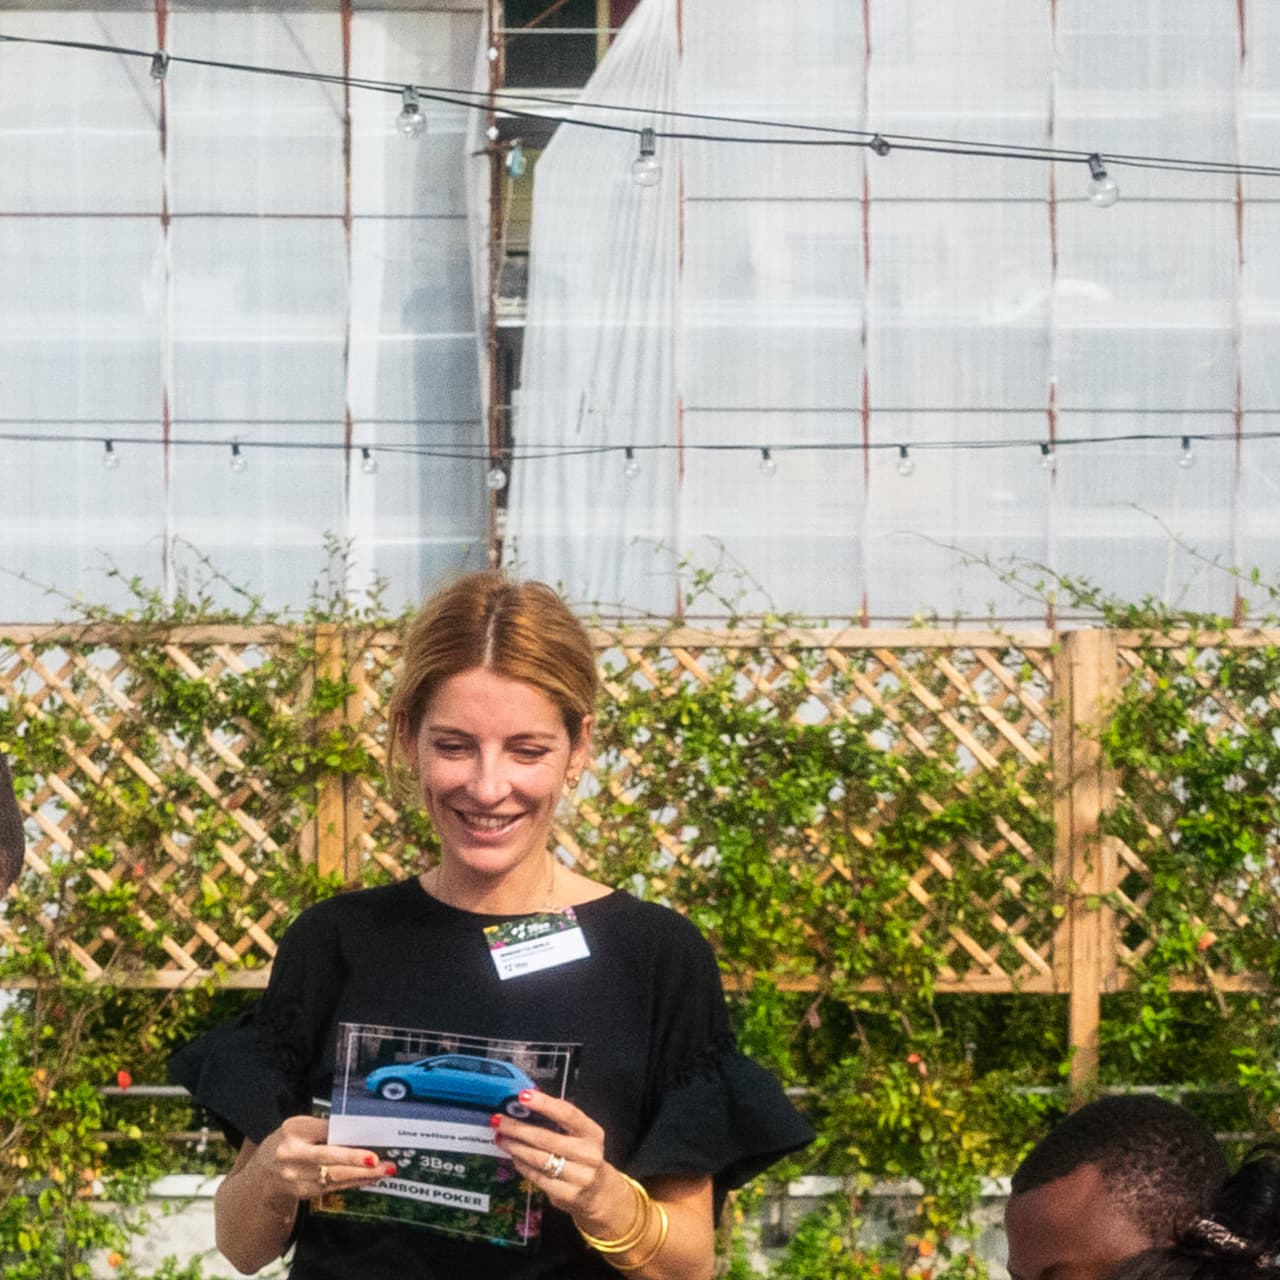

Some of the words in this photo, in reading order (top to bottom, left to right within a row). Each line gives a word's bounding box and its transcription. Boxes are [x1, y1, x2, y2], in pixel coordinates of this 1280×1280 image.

[419, 1155, 466, 1174] 3Bee
[368, 1180, 430, 1197] ARBON
[433, 1190, 483, 1206] POKER
